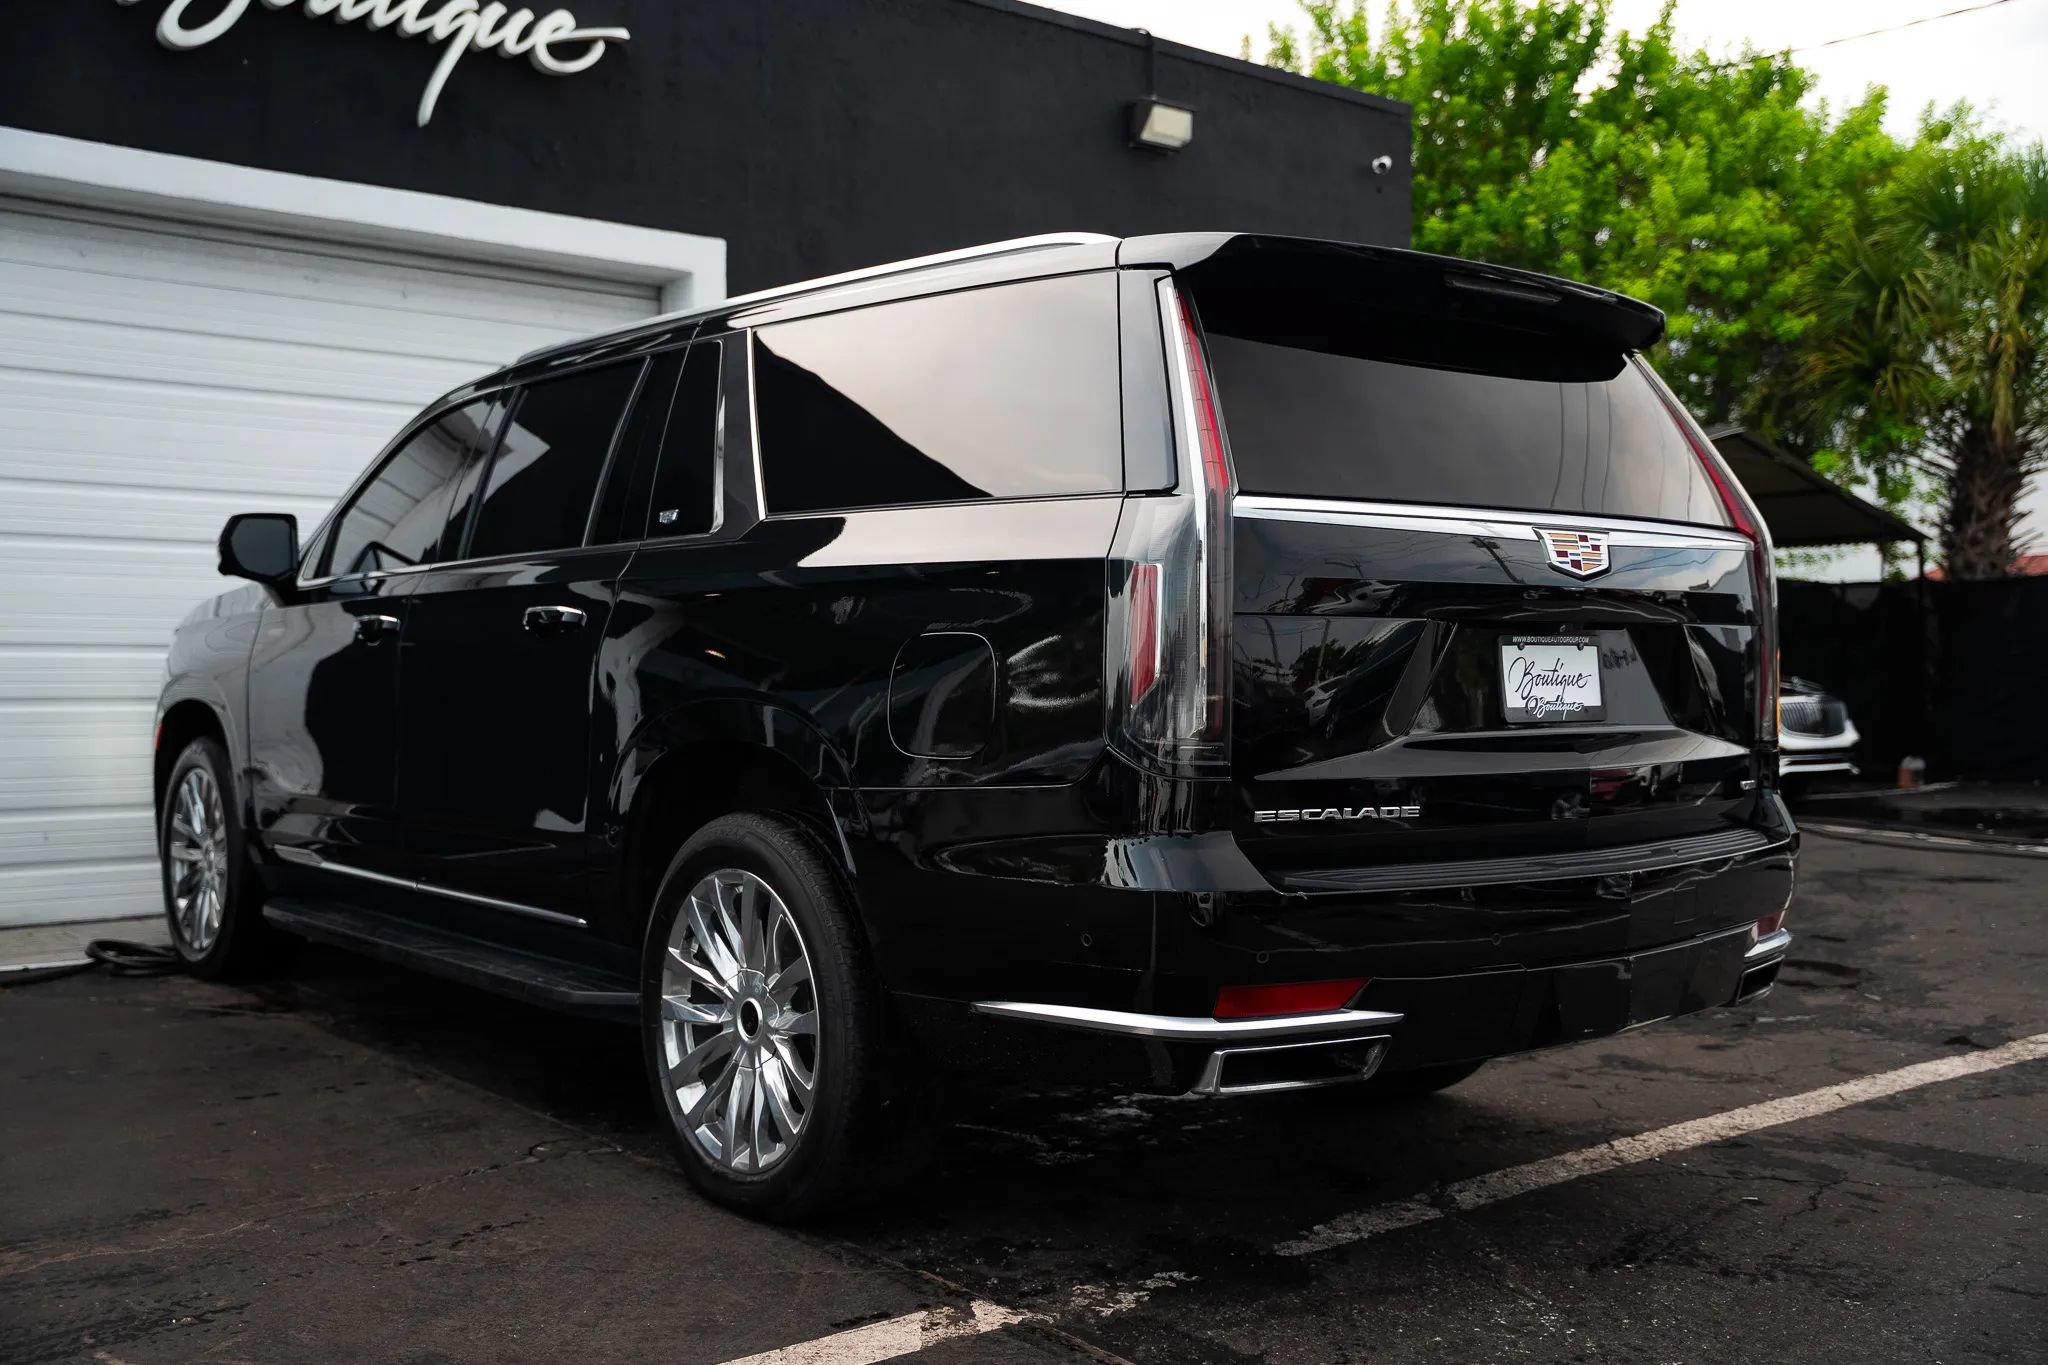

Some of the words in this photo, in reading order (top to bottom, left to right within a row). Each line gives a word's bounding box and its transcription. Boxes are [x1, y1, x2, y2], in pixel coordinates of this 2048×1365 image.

[115, 0, 631, 127] ique
[1508, 656, 1592, 702] Boutique
[1526, 694, 1584, 721] Boutique
[1253, 805, 1421, 823] ESCALADE
